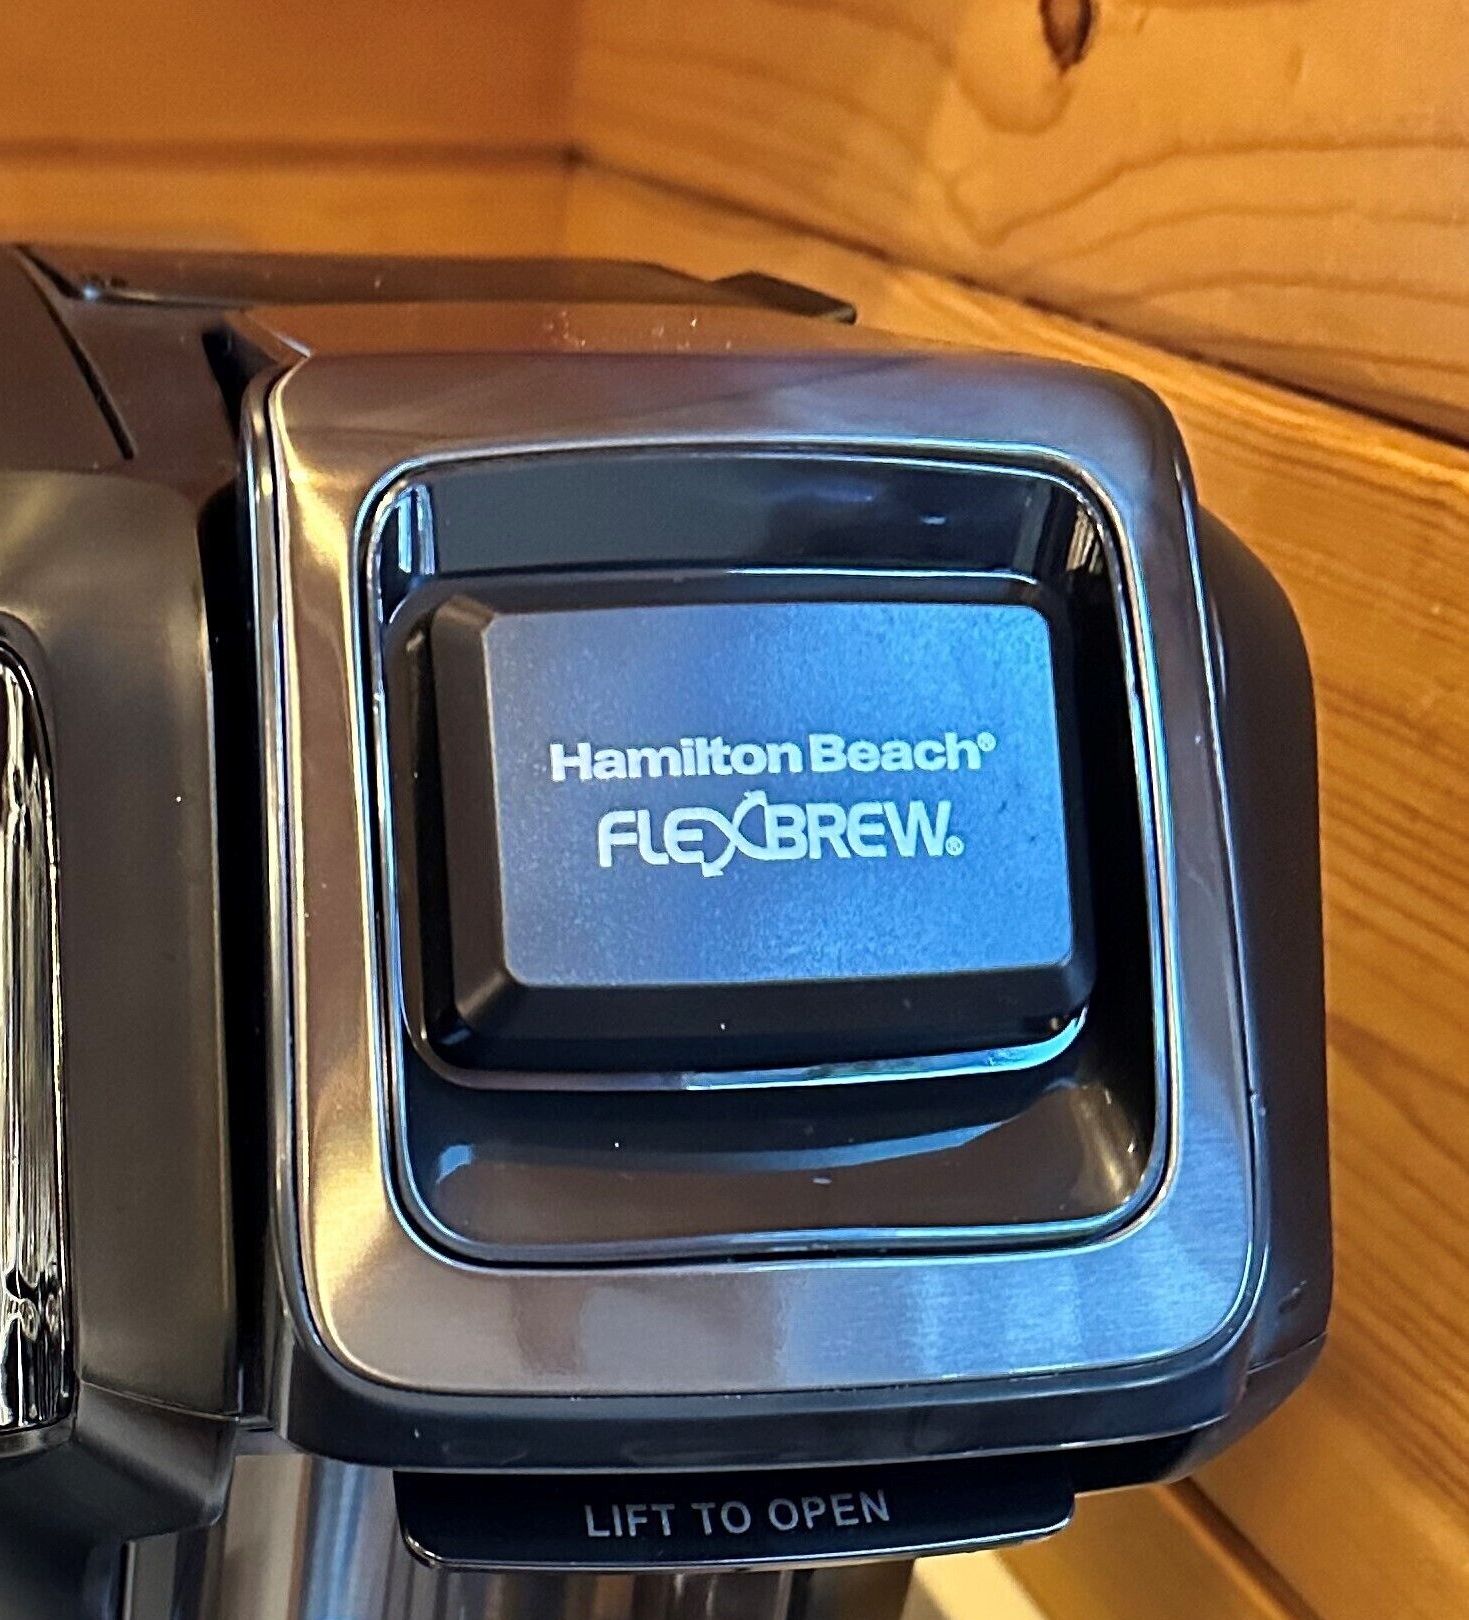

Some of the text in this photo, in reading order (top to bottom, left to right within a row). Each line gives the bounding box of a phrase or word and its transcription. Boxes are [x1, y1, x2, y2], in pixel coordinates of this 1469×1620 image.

[550, 737, 802, 781] Hamilton
[584, 1491, 890, 1537] LIFT TO OPEN
